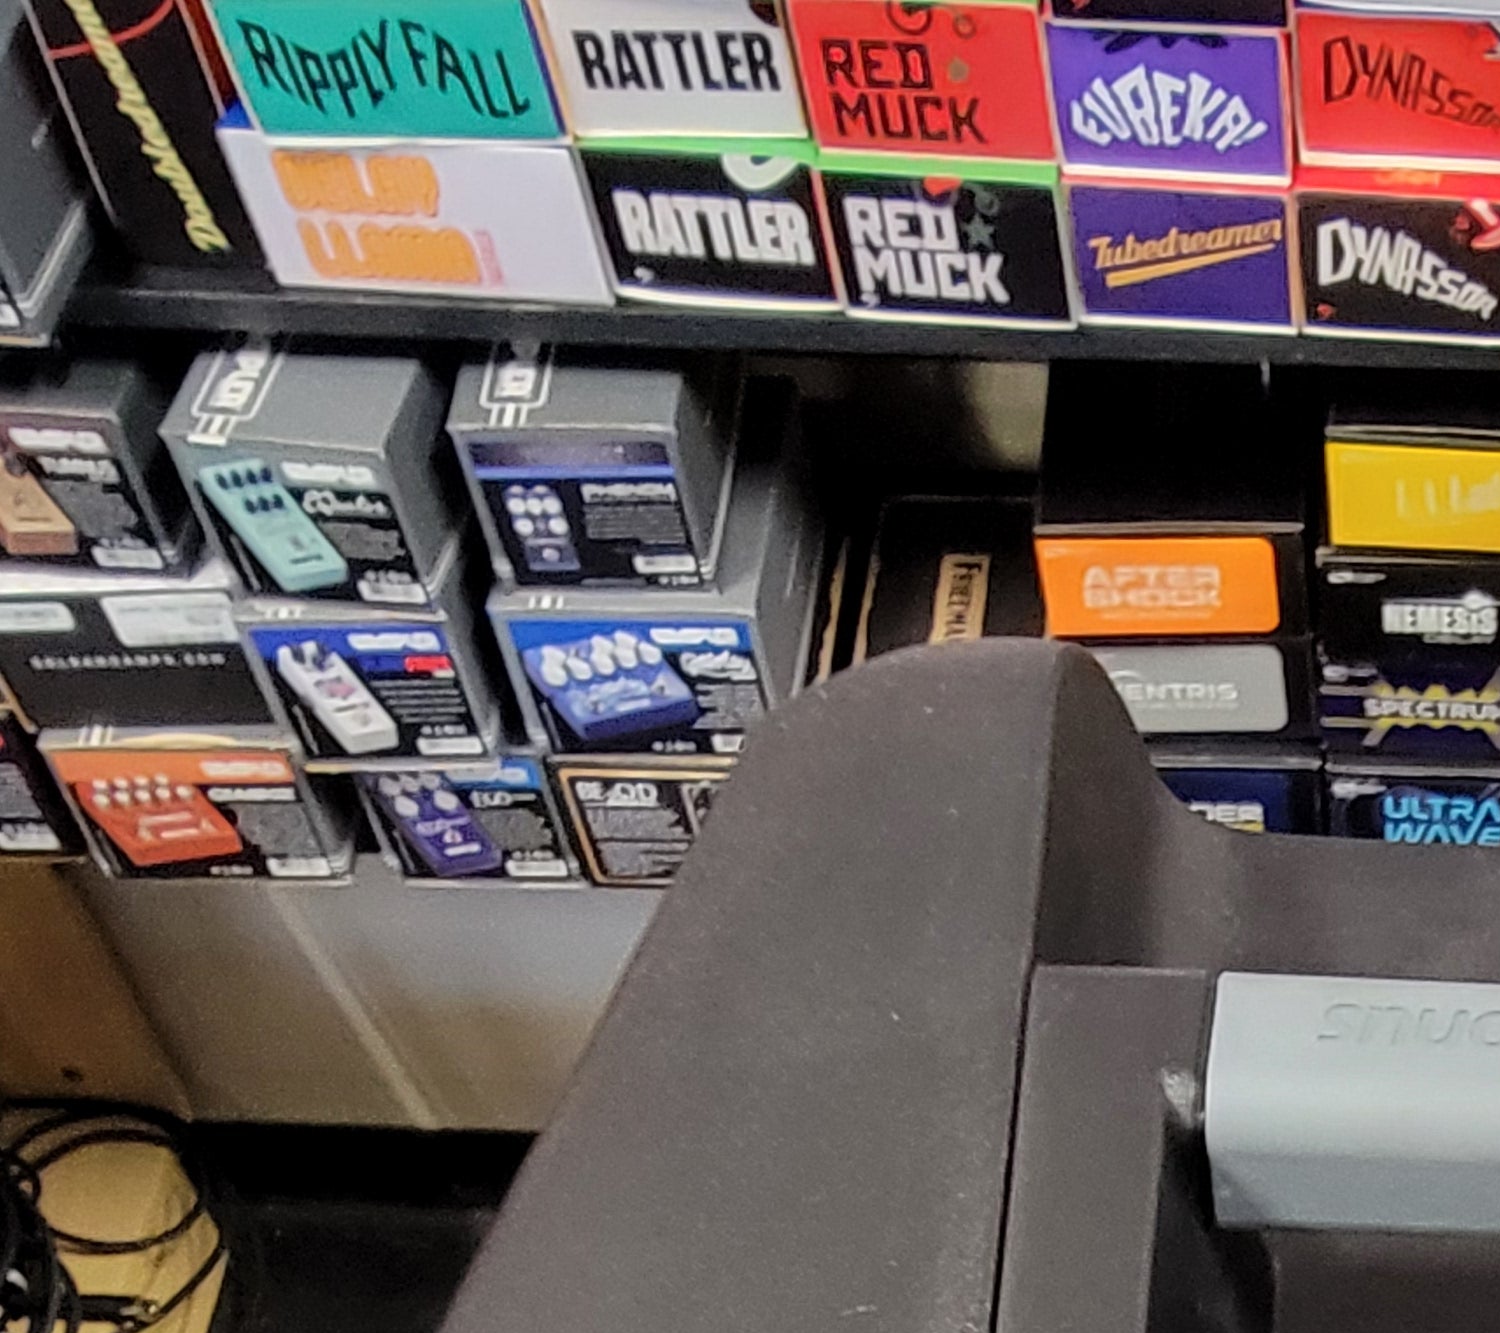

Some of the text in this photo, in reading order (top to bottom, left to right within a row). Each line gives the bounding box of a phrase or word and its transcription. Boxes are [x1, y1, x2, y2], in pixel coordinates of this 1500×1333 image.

[236, 18, 532, 118] RIPPLY FALL
[571, 30, 782, 92] RATTLER
[820, 39, 935, 91] RED
[829, 91, 988, 144] MUCK
[611, 190, 816, 267] RATTLER
[843, 194, 960, 252] RED
[1088, 219, 1282, 269] Tubedreamer
[852, 246, 1010, 305] MUCK
[1083, 564, 1221, 588] AFTER
